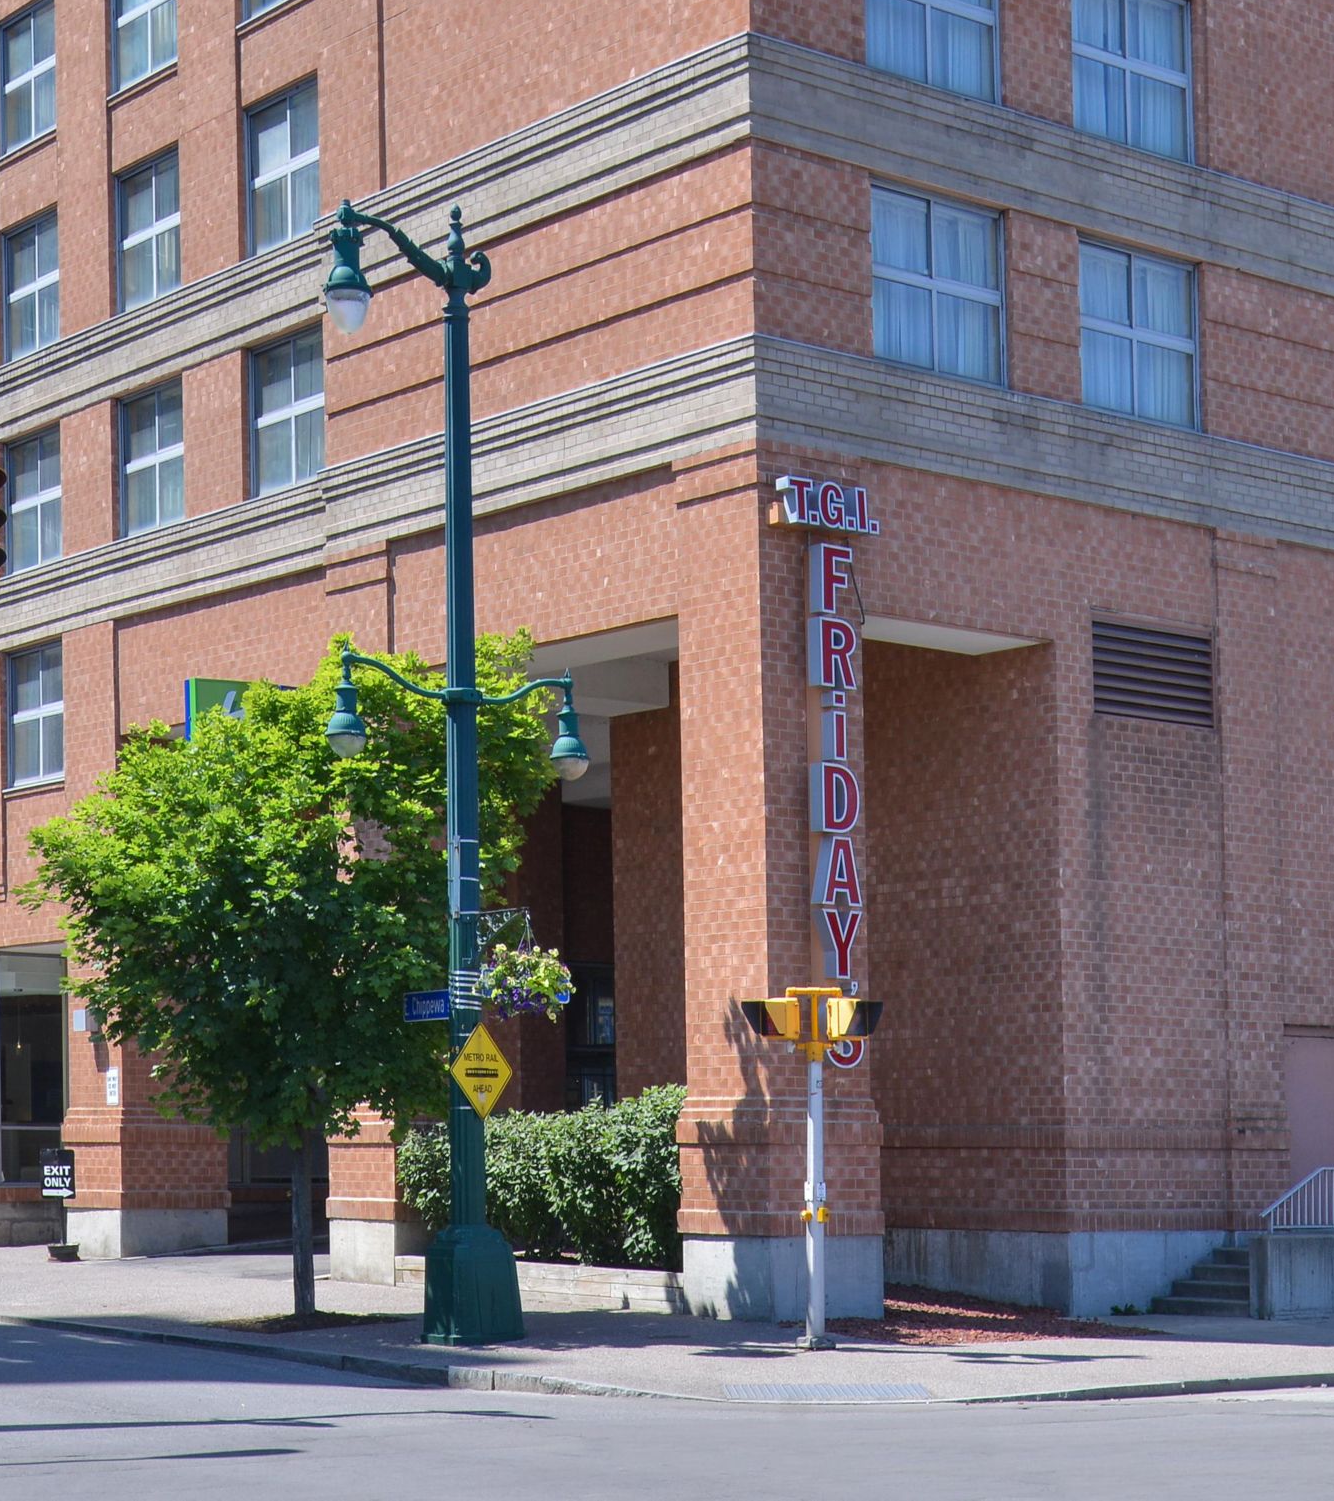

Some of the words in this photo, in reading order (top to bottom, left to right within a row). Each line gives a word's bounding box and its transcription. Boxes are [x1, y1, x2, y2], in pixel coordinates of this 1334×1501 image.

[786, 475, 880, 535] T.G.I.
[411, 995, 445, 1018] Chippewa
[463, 1053, 485, 1062] METRO
[485, 1054, 499, 1063] RAIL
[472, 1084, 493, 1093] AHEAD
[43, 1165, 72, 1176] EXIT
[43, 1176, 72, 1188] ONLY
